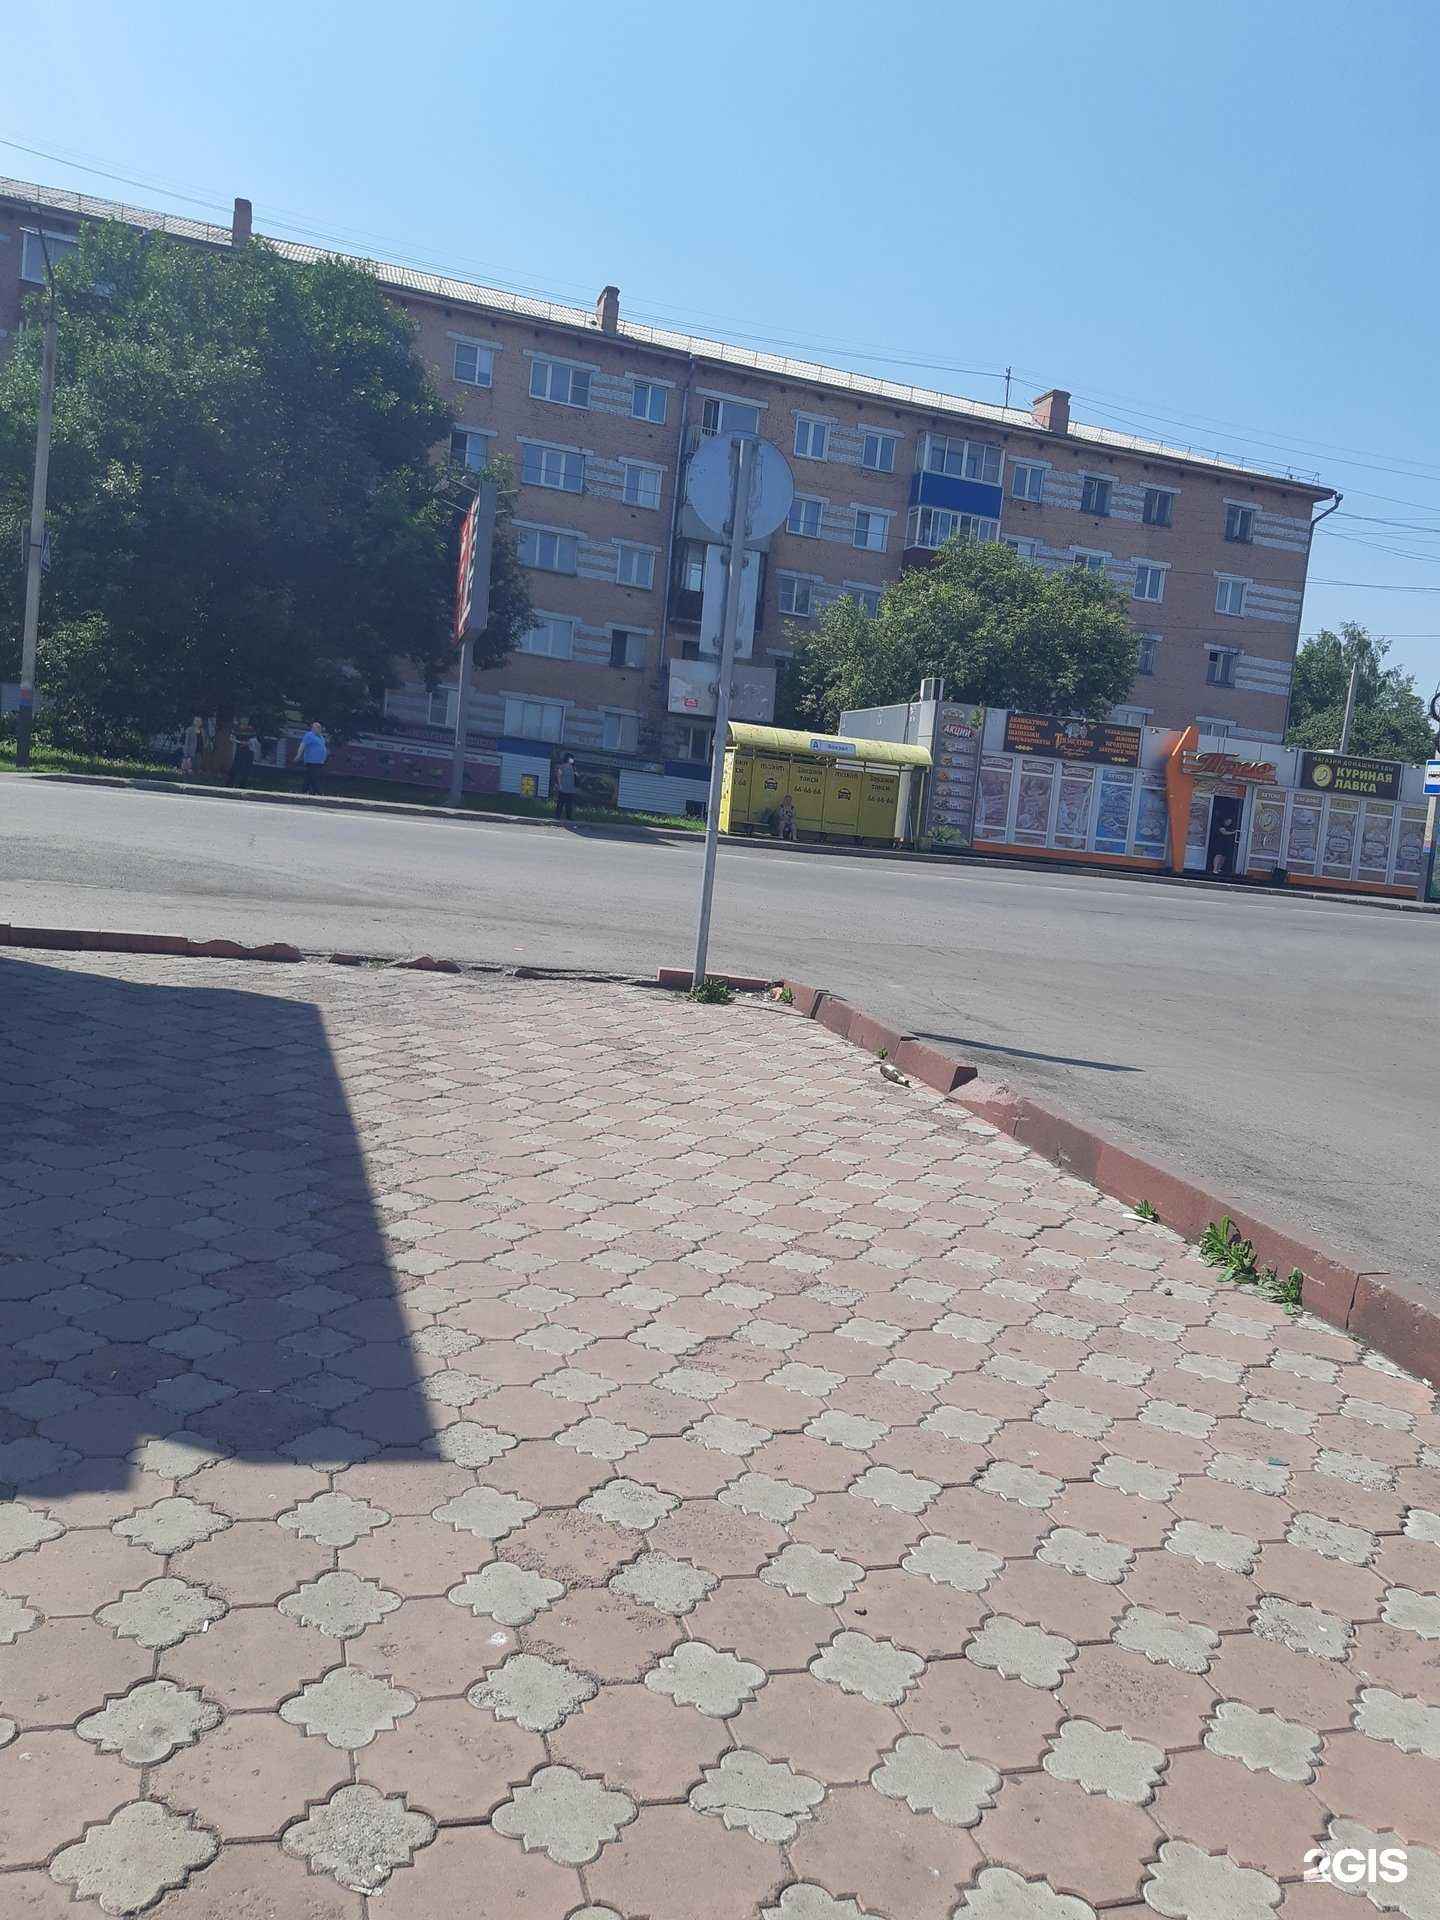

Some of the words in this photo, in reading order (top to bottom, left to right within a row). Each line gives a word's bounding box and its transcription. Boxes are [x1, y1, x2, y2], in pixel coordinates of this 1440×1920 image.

[943, 724, 971, 738] АКЦИИ
[1312, 756, 1342, 765] МАГАЗИН
[1336, 767, 1393, 783] КУРИНАЯ
[1334, 780, 1377, 793] ЛАВКА
